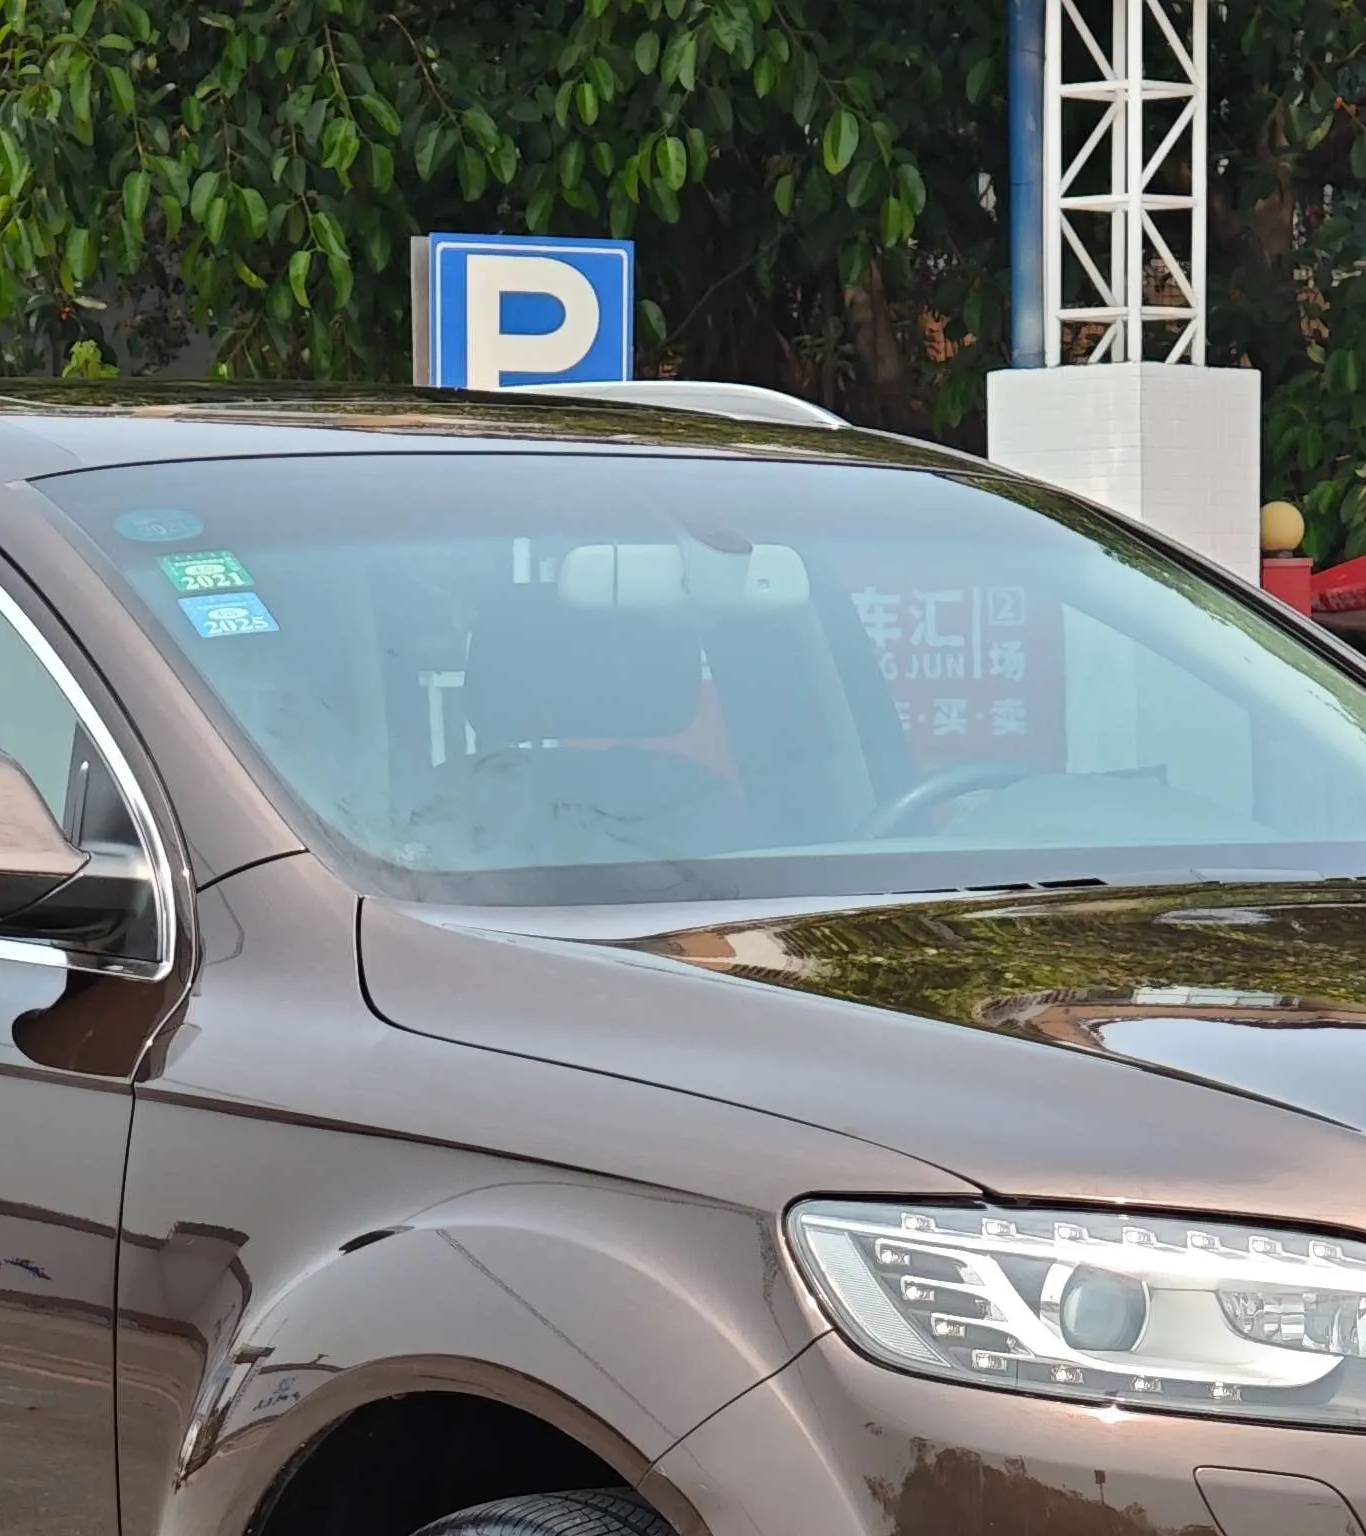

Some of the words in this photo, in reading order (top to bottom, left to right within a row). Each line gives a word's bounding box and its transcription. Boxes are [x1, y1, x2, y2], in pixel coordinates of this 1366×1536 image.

[467, 254, 600, 390] P
[181, 572, 245, 591] 2021
[203, 616, 269, 634] 2025
